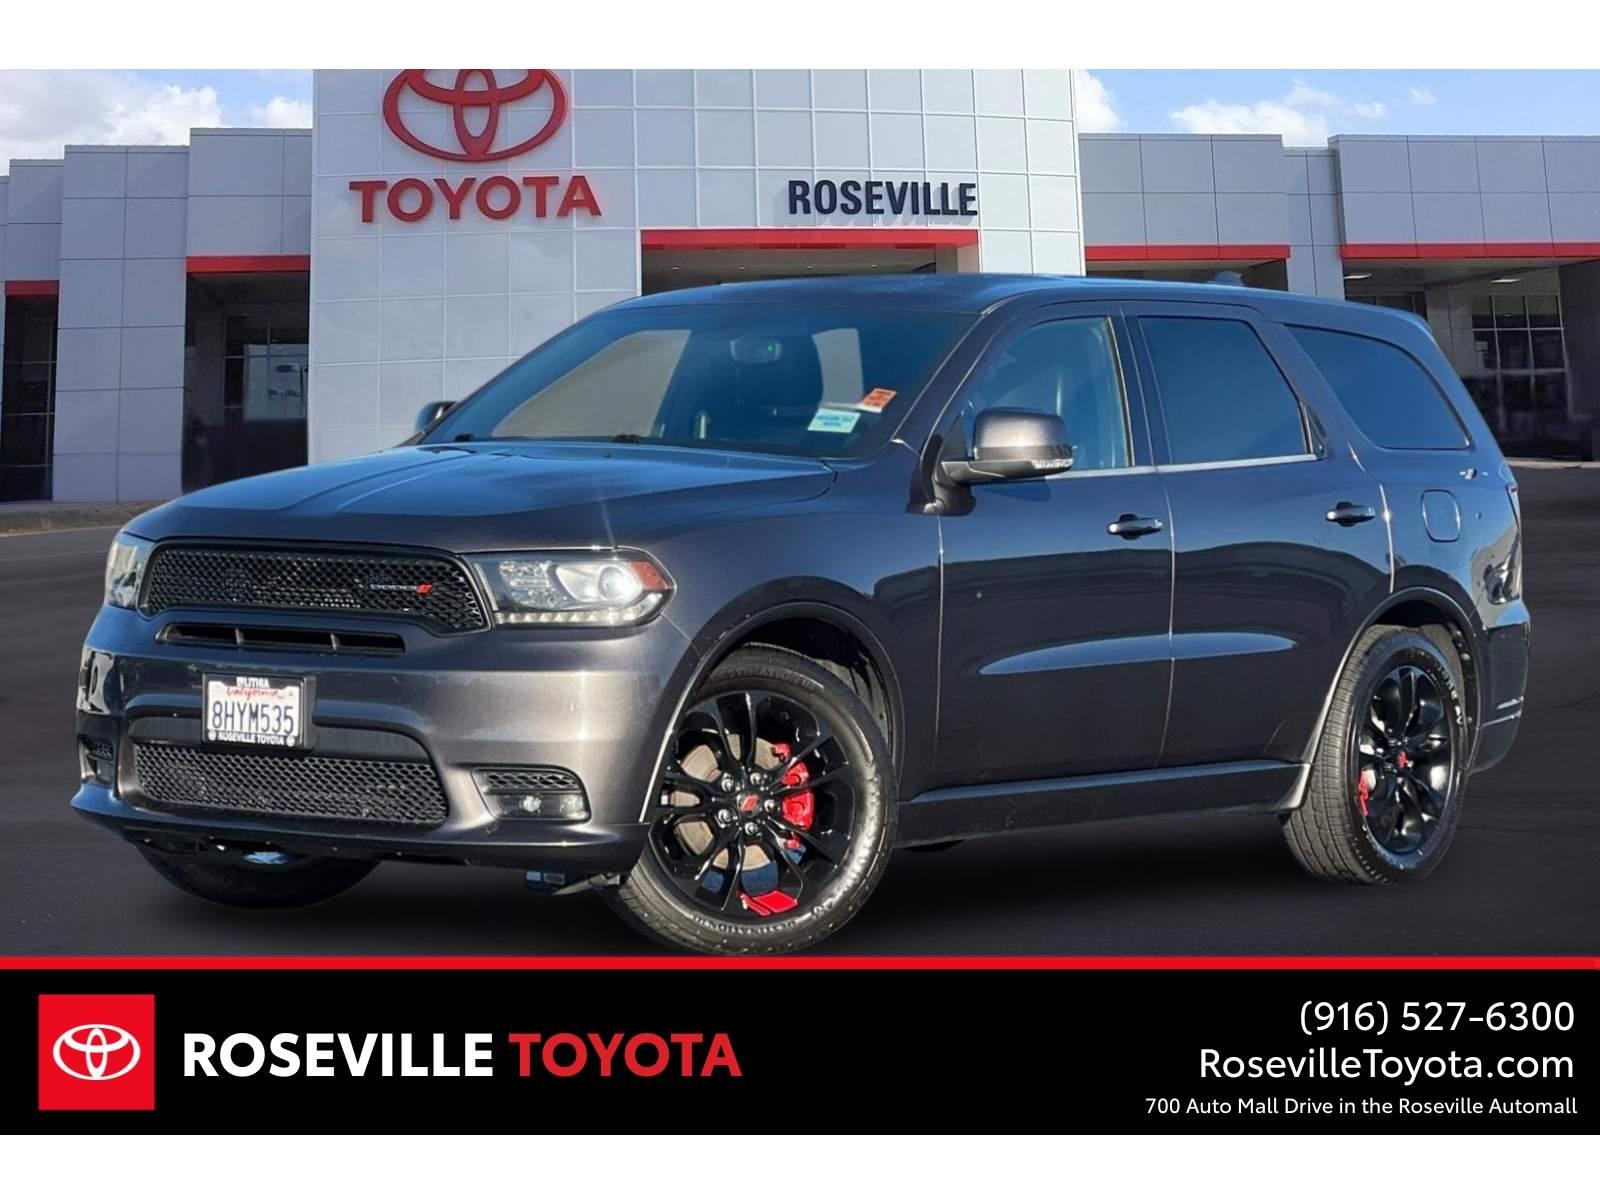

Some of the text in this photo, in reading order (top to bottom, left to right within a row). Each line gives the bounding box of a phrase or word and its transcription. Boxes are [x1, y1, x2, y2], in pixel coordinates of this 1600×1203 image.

[349, 175, 602, 223] TOYOTA
[788, 179, 978, 217] ROSEVILLE
[212, 700, 295, 735] 8HYM535
[217, 731, 285, 745] ROSEVILLE TOYOTA
